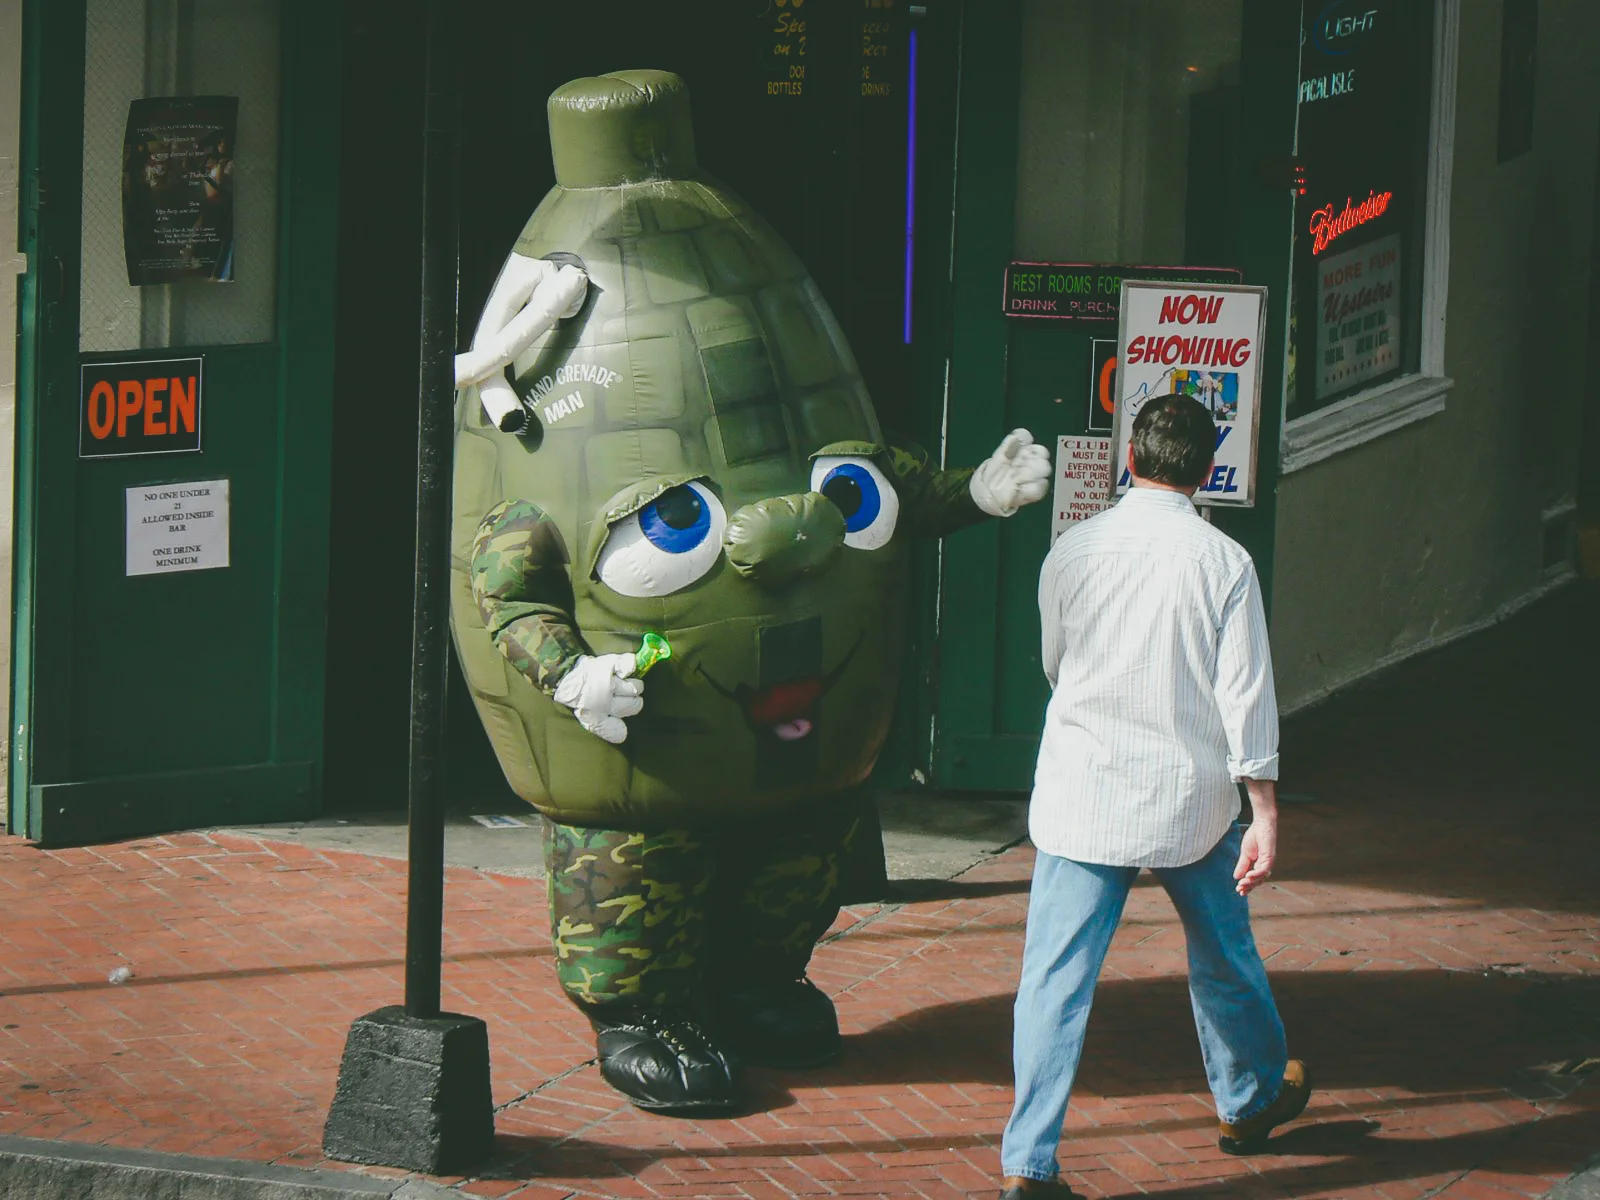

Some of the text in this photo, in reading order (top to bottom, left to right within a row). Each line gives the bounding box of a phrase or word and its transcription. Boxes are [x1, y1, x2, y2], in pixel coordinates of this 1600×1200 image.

[1324, 9, 1378, 40] LIGHT
[767, 82, 891, 96] BOTTLES DRINKS
[1331, 69, 1355, 96] ISLE
[1309, 190, 1392, 256] Budweiser
[1323, 247, 1396, 289] MORE FUN
[1013, 274, 1044, 293] REST
[1048, 275, 1092, 294] ROOMS
[1098, 276, 1121, 295] FOR
[1011, 298, 1119, 314] DRINK PURCH
[1323, 280, 1394, 324] Upstairs
[1158, 294, 1225, 325] NOW
[1127, 335, 1251, 368] SHOWING
[524, 375, 554, 411] HAND
[88, 376, 196, 440] OPEN
[543, 390, 585, 424] MAN
[1063, 440, 1109, 451] CLUB
[1072, 451, 1109, 461] MUST BE
[1068, 462, 1109, 472] EVERYONE
[1064, 471, 1086, 480] MUST
[1084, 480, 1095, 488] NO
[144, 489, 210, 501] NO ONE UNDER
[1074, 491, 1086, 500] NO
[1070, 502, 1100, 512] PROPER
[142, 510, 214, 524] ALLOWED INSIDE
[169, 524, 186, 532] BAR
[152, 545, 202, 557] ONE DRINK
[156, 557, 198, 567] MINIMUM
